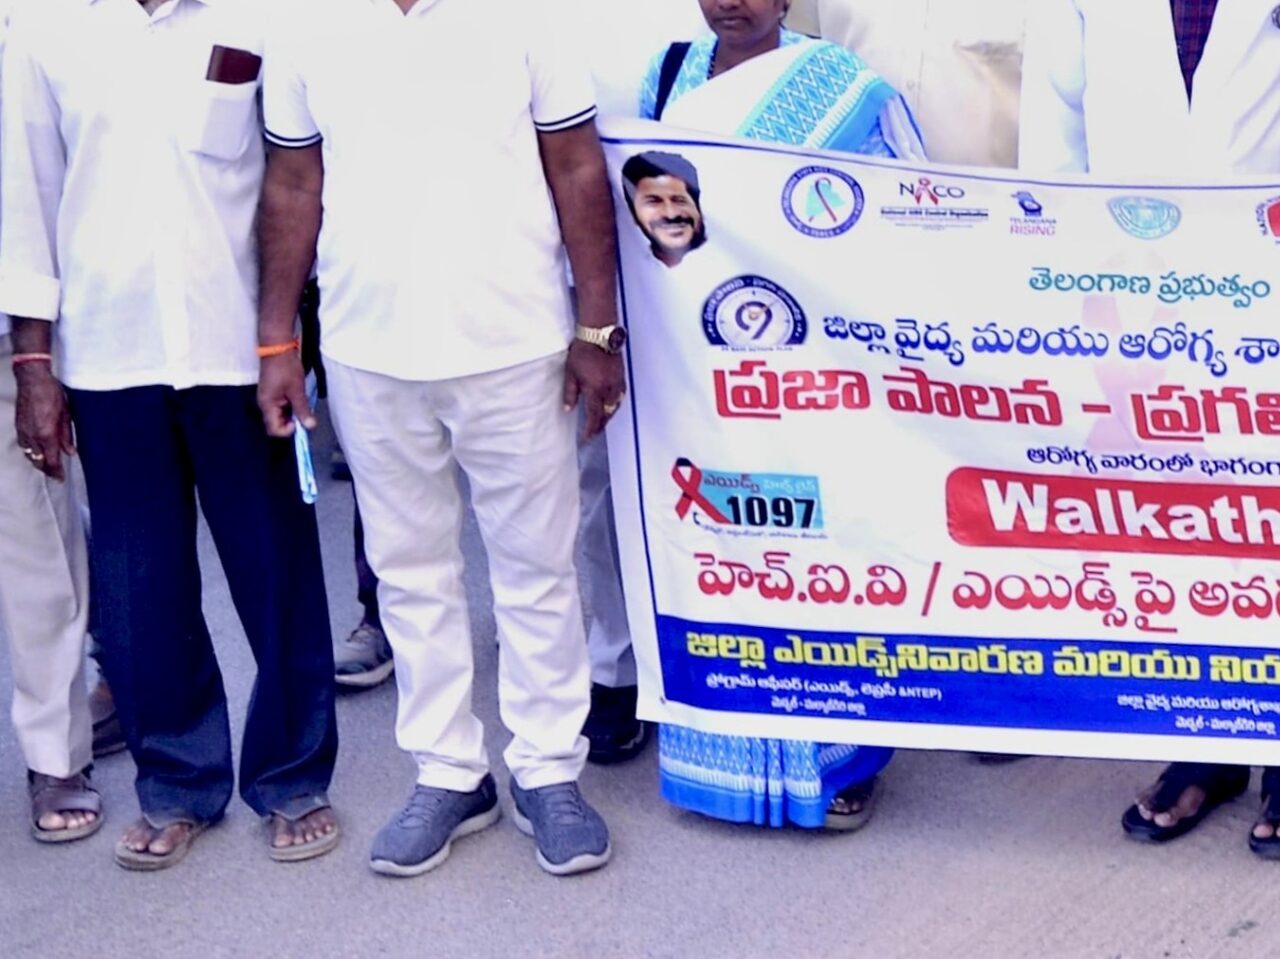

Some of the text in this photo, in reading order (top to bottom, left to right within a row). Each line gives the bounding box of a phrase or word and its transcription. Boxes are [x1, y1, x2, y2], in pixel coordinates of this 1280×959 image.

[1010, 225, 1056, 236] RISING
[1029, 267, 1270, 308] తెలంగాణ ప్రభుత్వం
[823, 315, 891, 354] జిల్లా
[894, 318, 966, 366] వైద్య
[971, 323, 1109, 358] మరియు
[1119, 322, 1228, 377] ఆరోగ్య
[713, 360, 872, 420] ప్రజా
[883, 365, 1064, 427] పాలన
[1027, 446, 1099, 474] ఆరోగ్య
[1101, 453, 1195, 473] వారంలో
[726, 496, 815, 529] 1097
[693, 551, 907, 607] హెచ్.ఐ.వి
[686, 630, 767, 670] జిల్లా
[1053, 642, 1201, 682] మరియు
